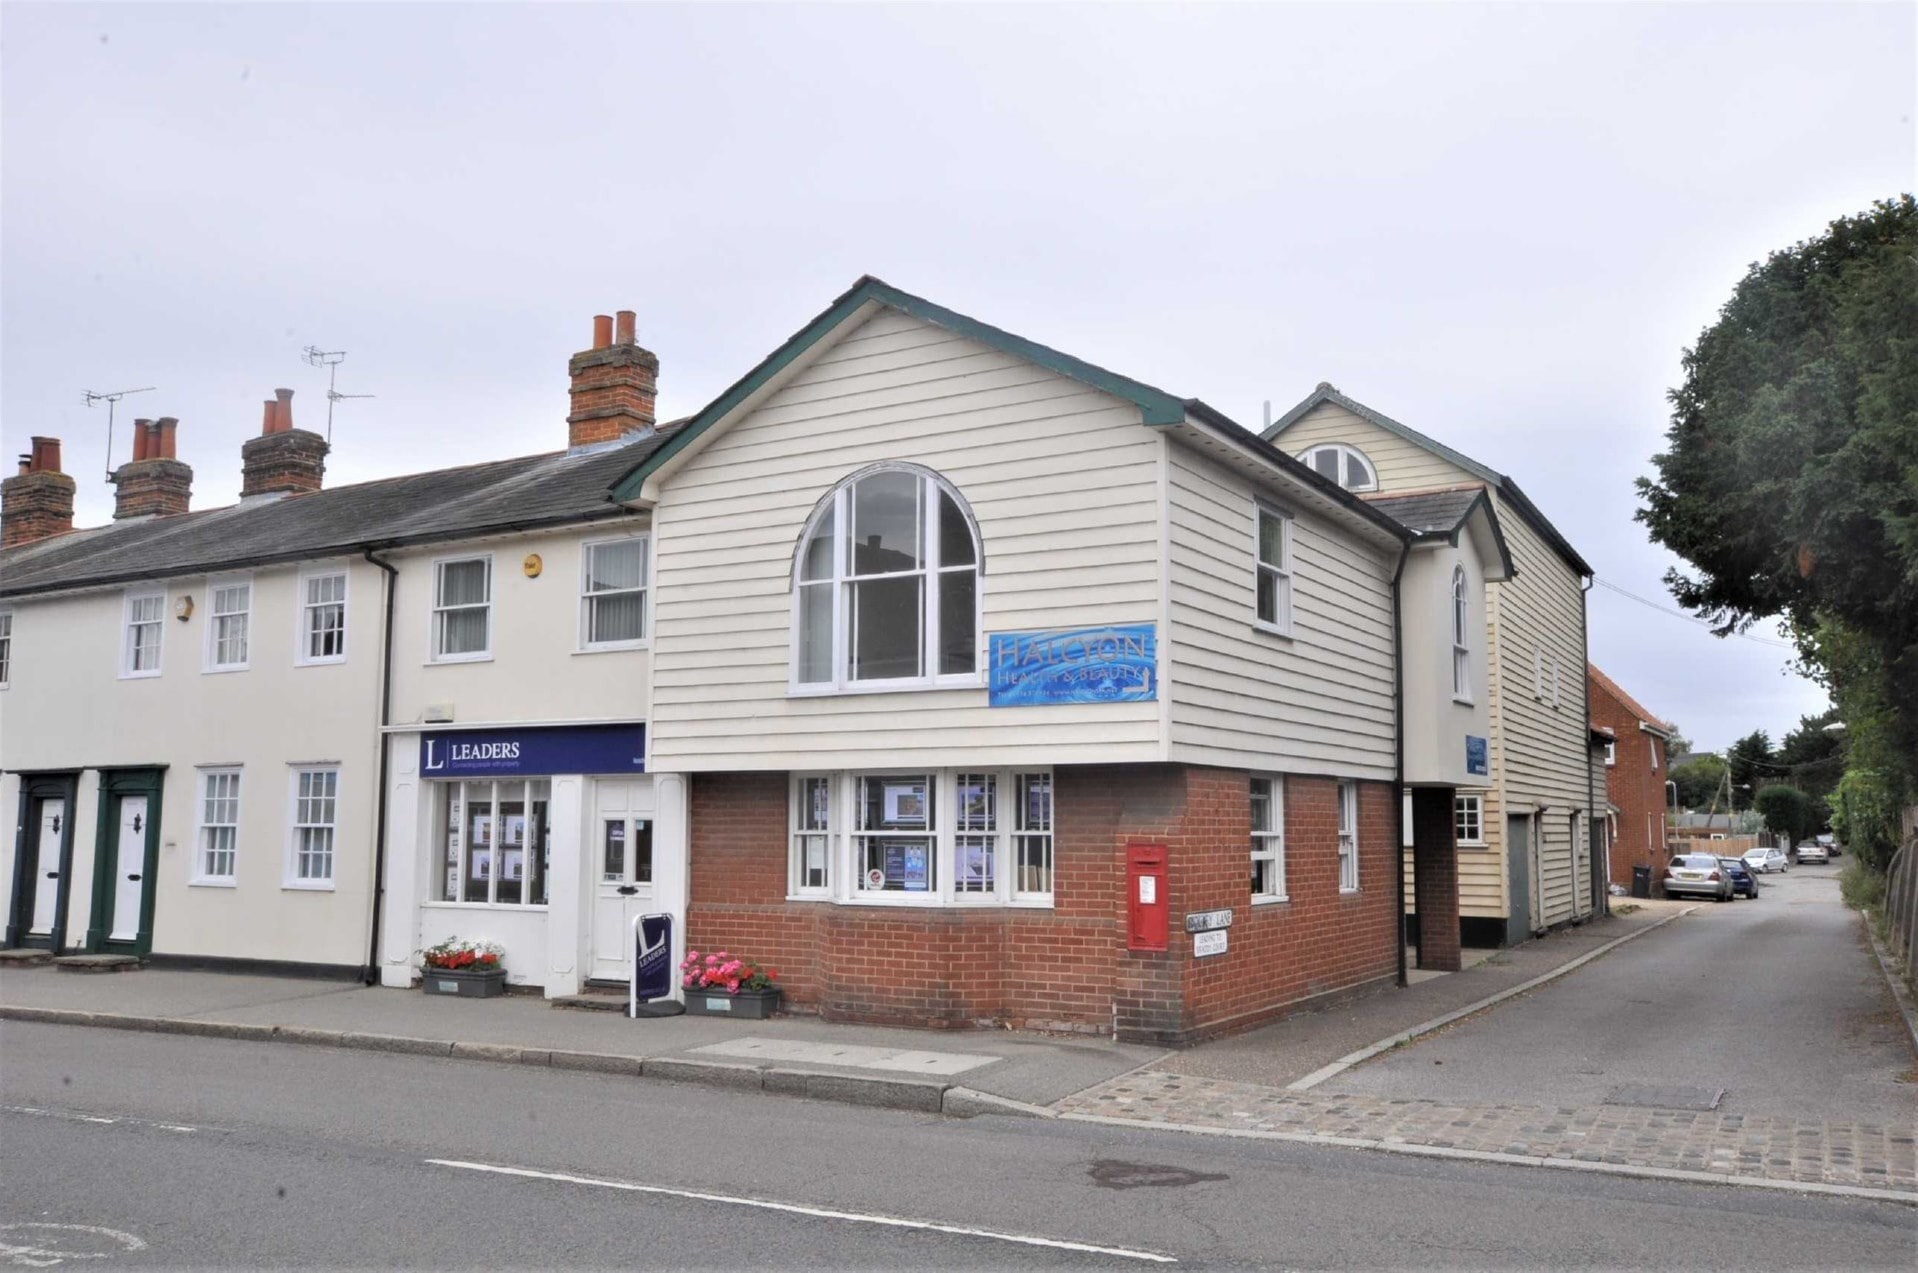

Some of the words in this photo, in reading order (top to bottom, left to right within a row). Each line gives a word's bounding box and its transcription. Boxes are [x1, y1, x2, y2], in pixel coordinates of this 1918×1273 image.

[997, 632, 1145, 667] HALCYON
[998, 669, 1057, 685] HEALTH
[1063, 672, 1074, 682] &
[1080, 666, 1141, 681] BEAUTY
[425, 740, 444, 770] L
[452, 742, 520, 760] LEADERS
[639, 945, 667, 968] LEADERS
